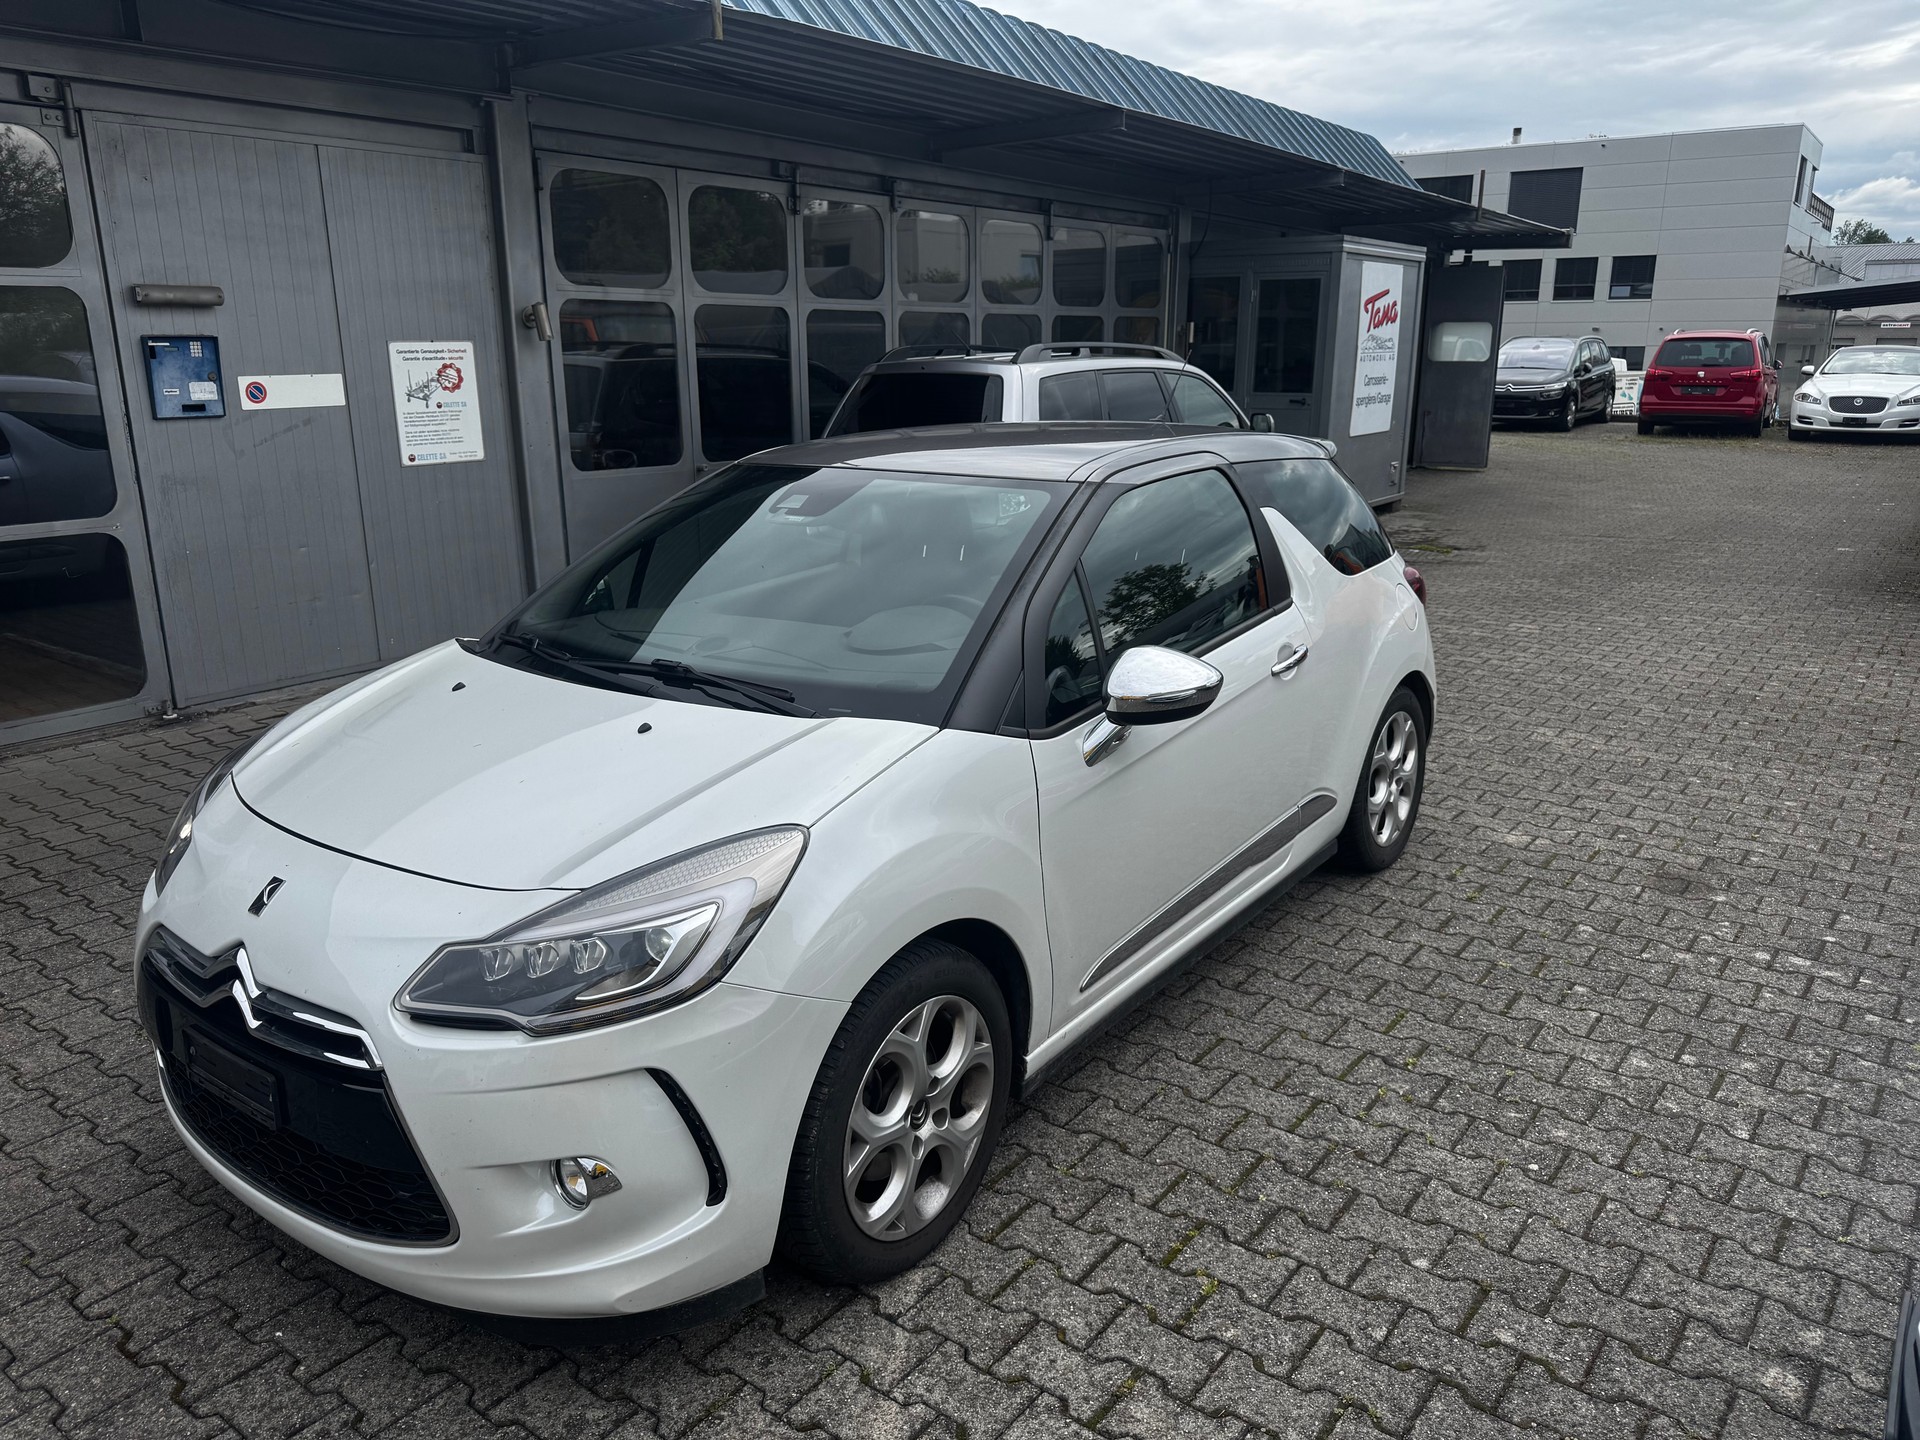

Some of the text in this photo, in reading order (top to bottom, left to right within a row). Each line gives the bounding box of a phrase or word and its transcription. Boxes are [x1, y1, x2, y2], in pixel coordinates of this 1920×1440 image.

[1364, 289, 1398, 333] Tana
[1377, 392, 1391, 407] Garage
[417, 452, 439, 461] CELETTE
